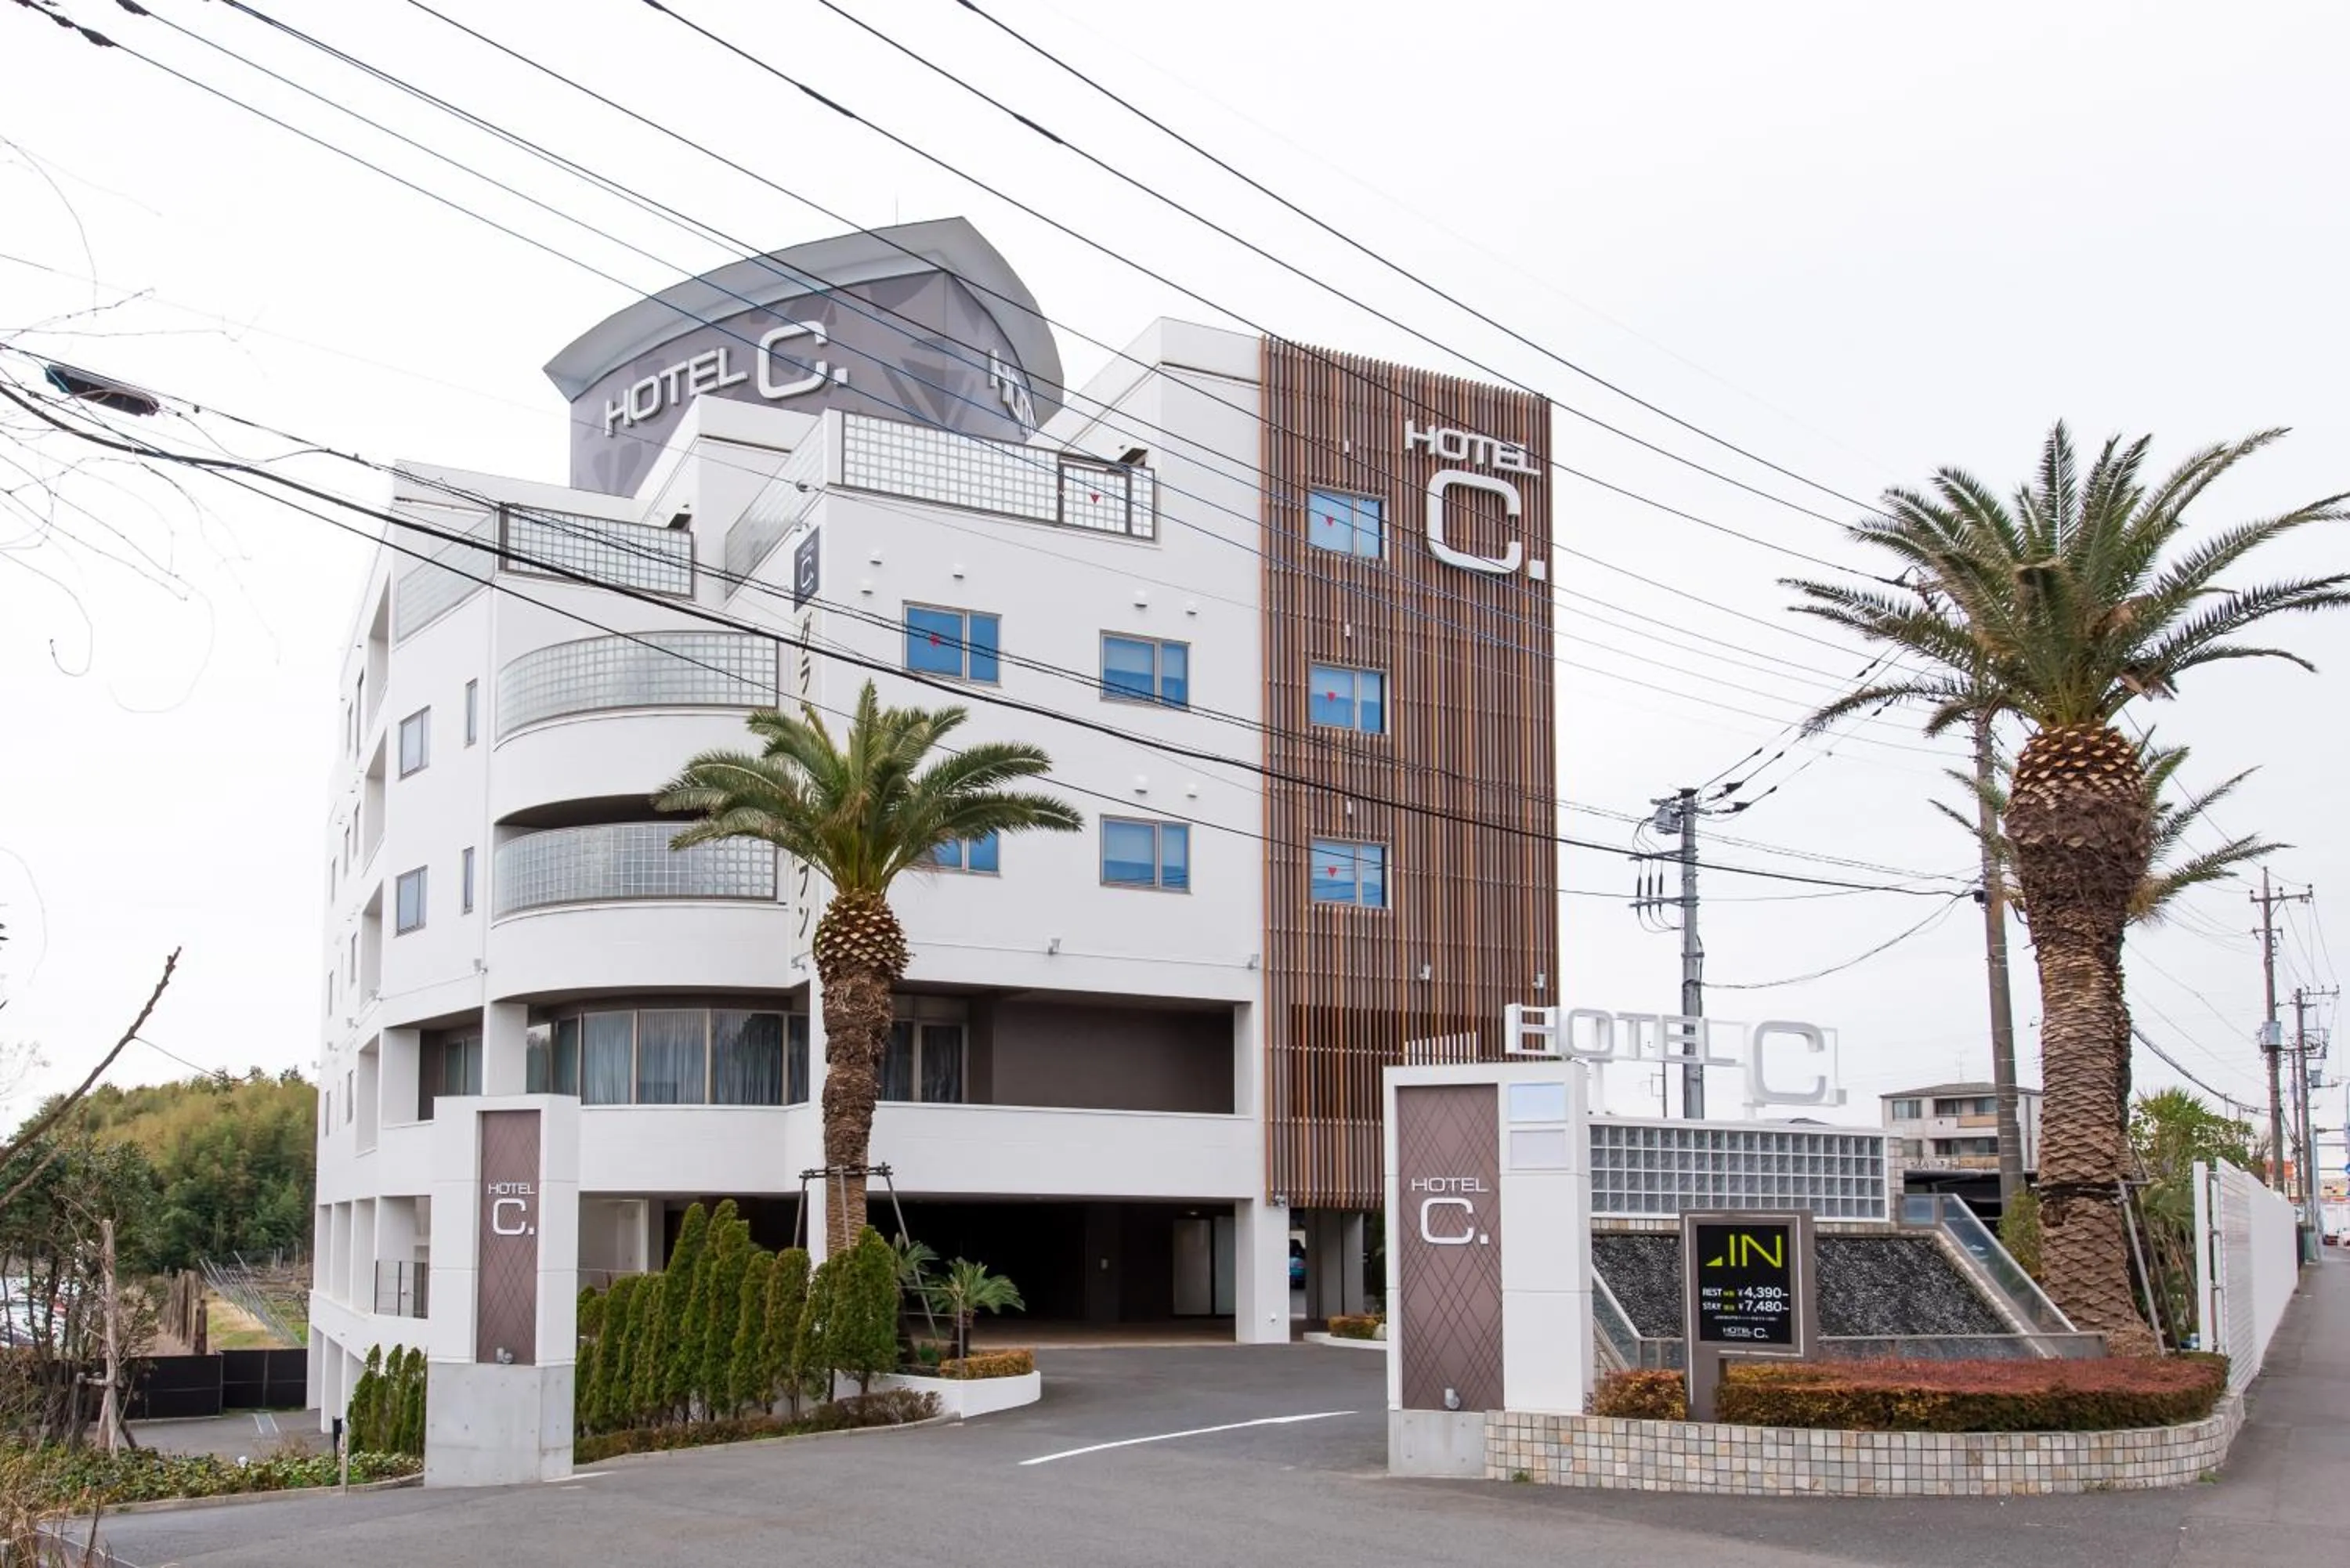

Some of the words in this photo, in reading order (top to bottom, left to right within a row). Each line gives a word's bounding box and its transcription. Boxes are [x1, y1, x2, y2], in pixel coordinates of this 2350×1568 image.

[605, 348, 747, 437] HOTEL
[757, 321, 848, 399] C.
[1405, 421, 1541, 475] HOTEL
[1428, 470, 1546, 580] C.
[1505, 1004, 1736, 1066] HOTEL
[489, 1182, 535, 1194] HOTEL
[1412, 1178, 1488, 1192] HOTEL
[493, 1198, 534, 1235] C.
[1421, 1198, 1488, 1245] C.
[1730, 1234, 1782, 1268] IN
[1703, 1288, 1722, 1297] REST
